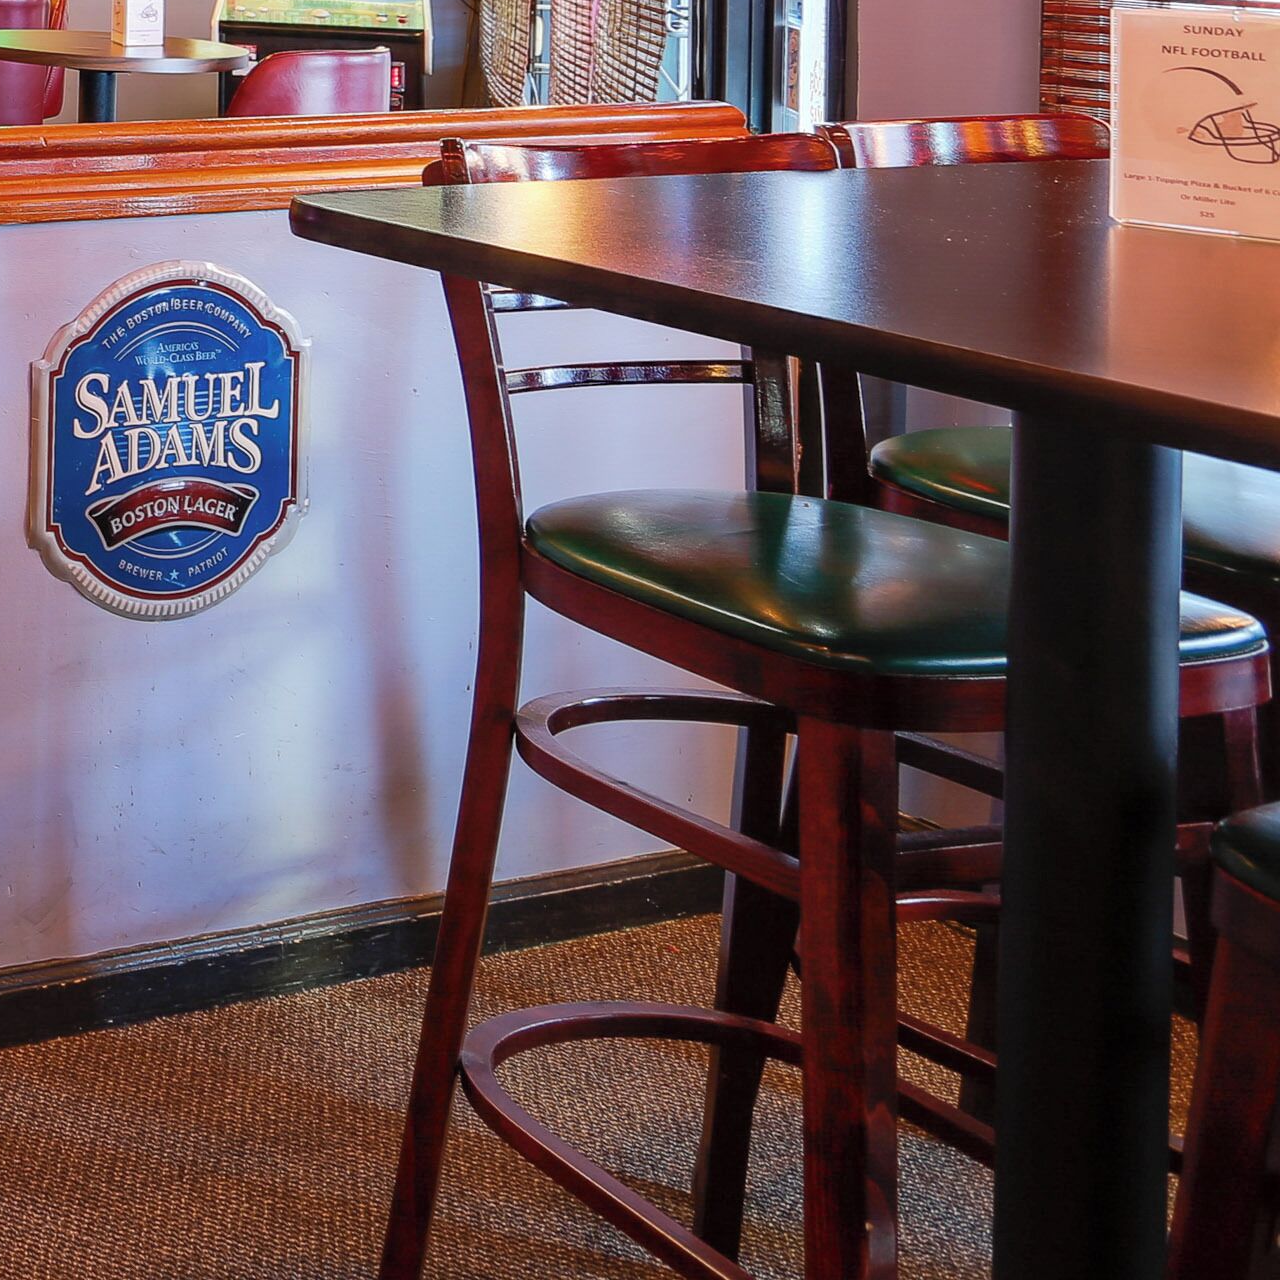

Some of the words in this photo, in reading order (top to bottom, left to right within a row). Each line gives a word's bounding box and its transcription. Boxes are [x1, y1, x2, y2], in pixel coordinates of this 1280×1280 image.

[1183, 24, 1245, 38] SUNDAY
[1161, 44, 1187, 57] NFL
[1191, 46, 1267, 62] FOOTBALL
[1180, 193, 1191, 201] Or
[1192, 195, 1218, 204] Miller
[1191, 180, 1212, 189] Pizza
[1222, 183, 1252, 193] Bucket
[102, 327, 127, 350] THE
[127, 302, 170, 330] BOSTON
[174, 298, 204, 311] BEER
[206, 302, 252, 339] COMPANY
[73, 361, 280, 439] SAMUEL
[84, 417, 263, 496] ADAMS
[110, 496, 181, 536] BOSTON
[183, 495, 238, 522] LAGER
[118, 559, 164, 582] BREWER
[187, 547, 229, 577] PATRIOT
